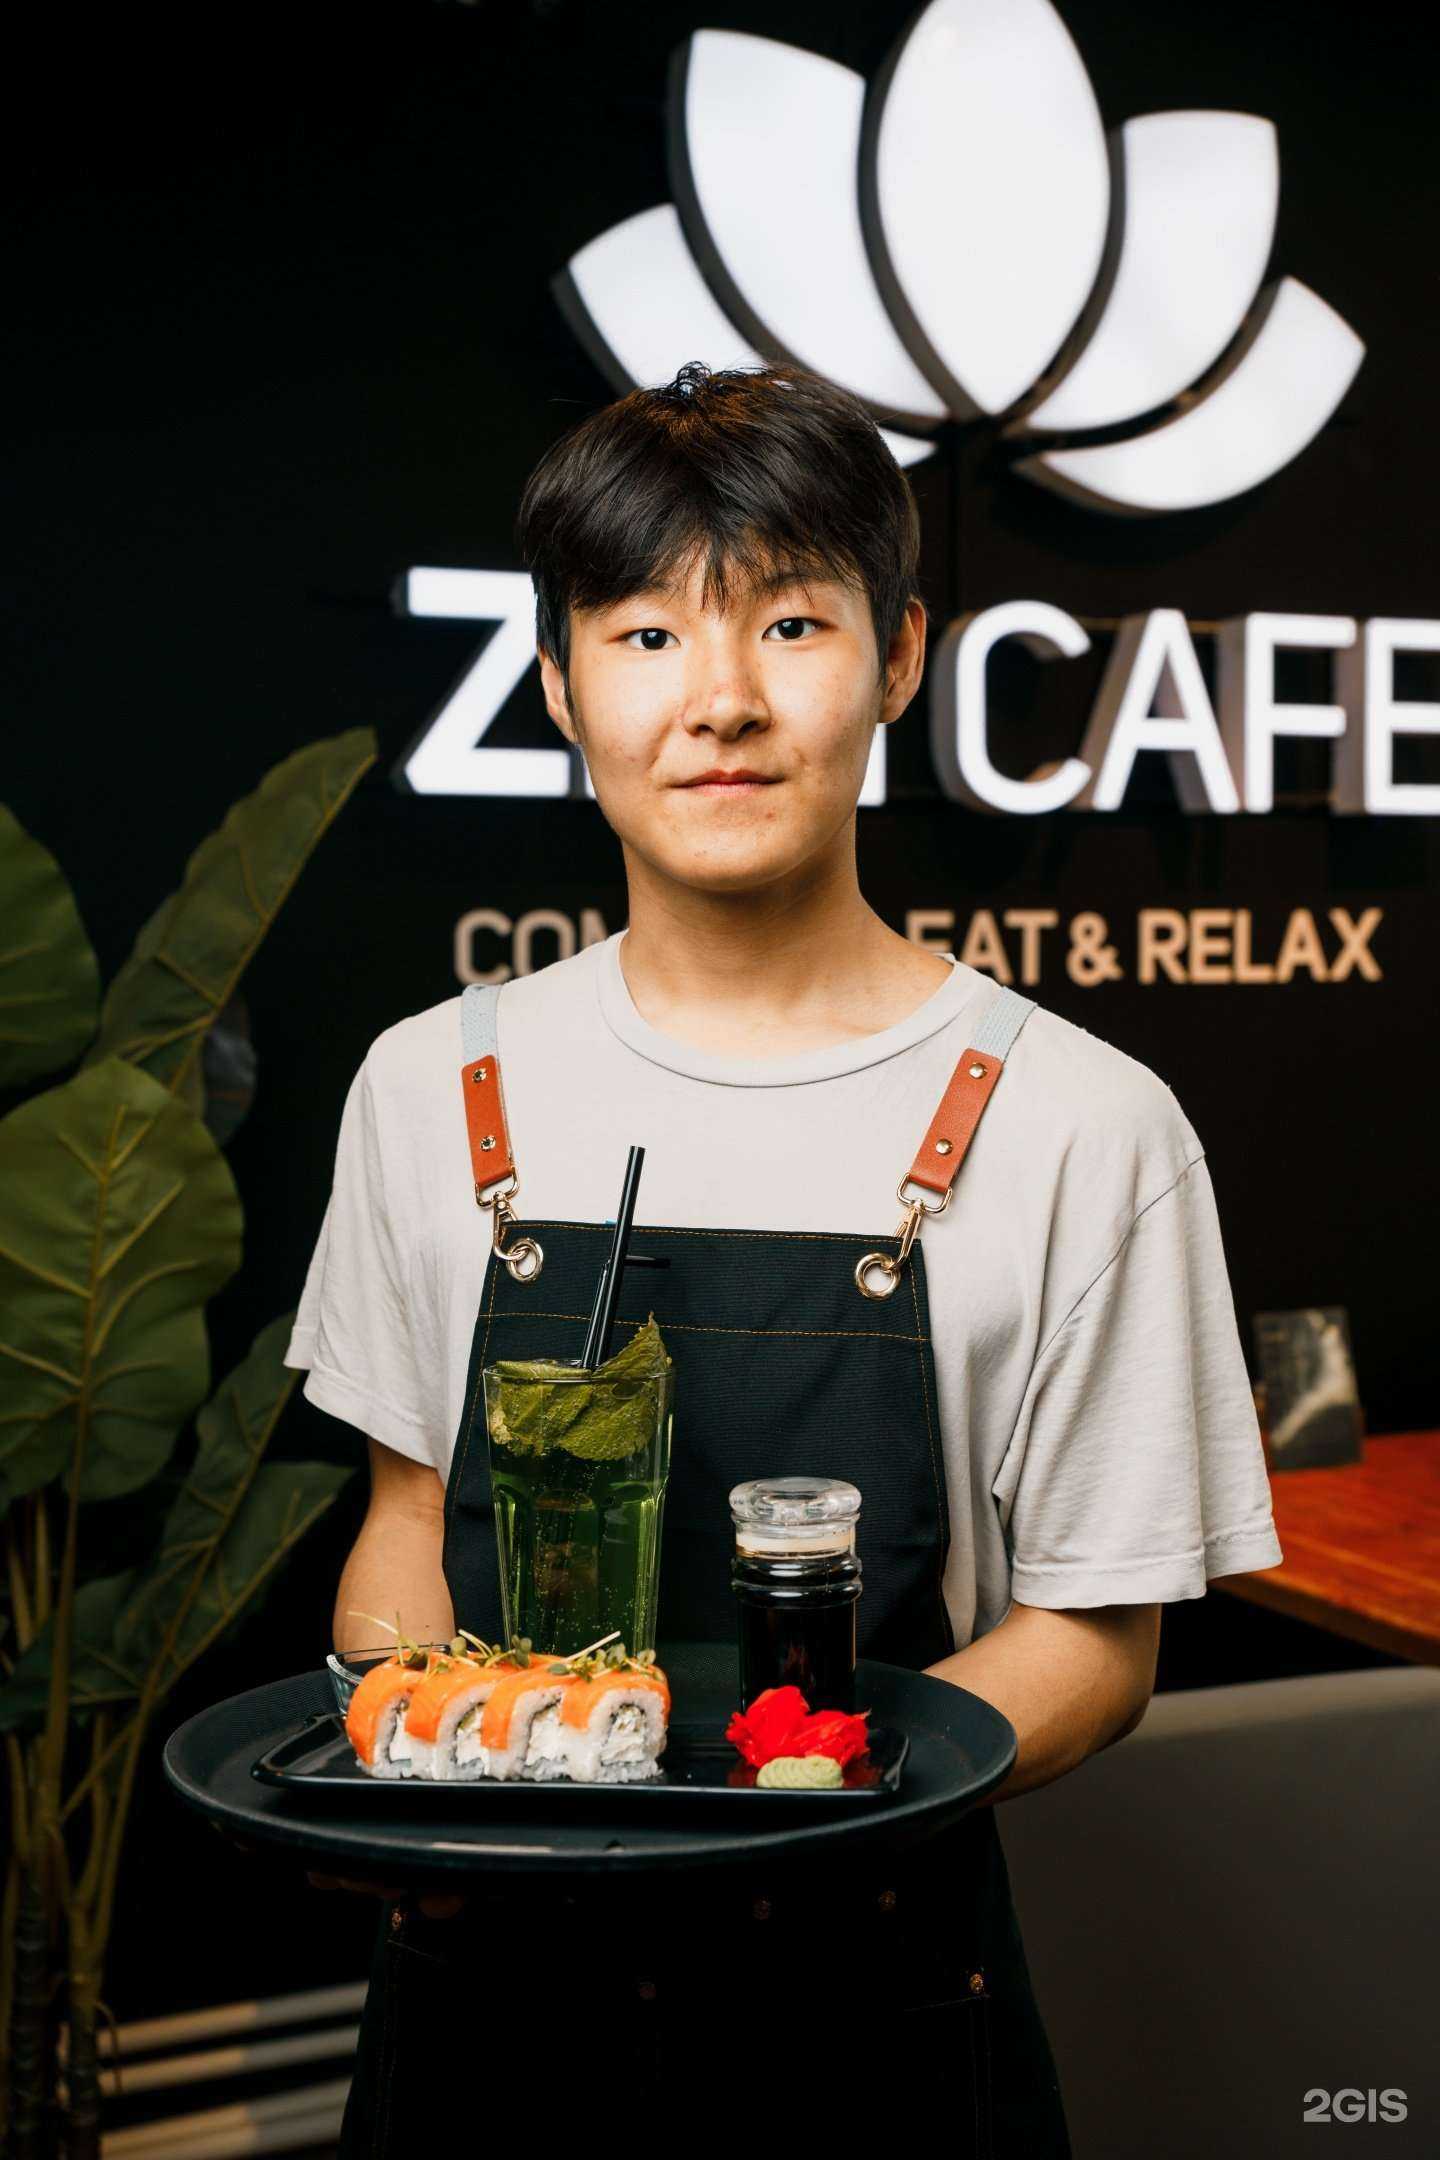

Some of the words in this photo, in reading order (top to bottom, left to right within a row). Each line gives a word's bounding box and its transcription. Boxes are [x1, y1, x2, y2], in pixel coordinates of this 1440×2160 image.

[954, 599, 1440, 815] CAFE
[454, 907, 609, 985] CO
[1066, 911, 1124, 987] &
[1137, 907, 1383, 985] RELAX
